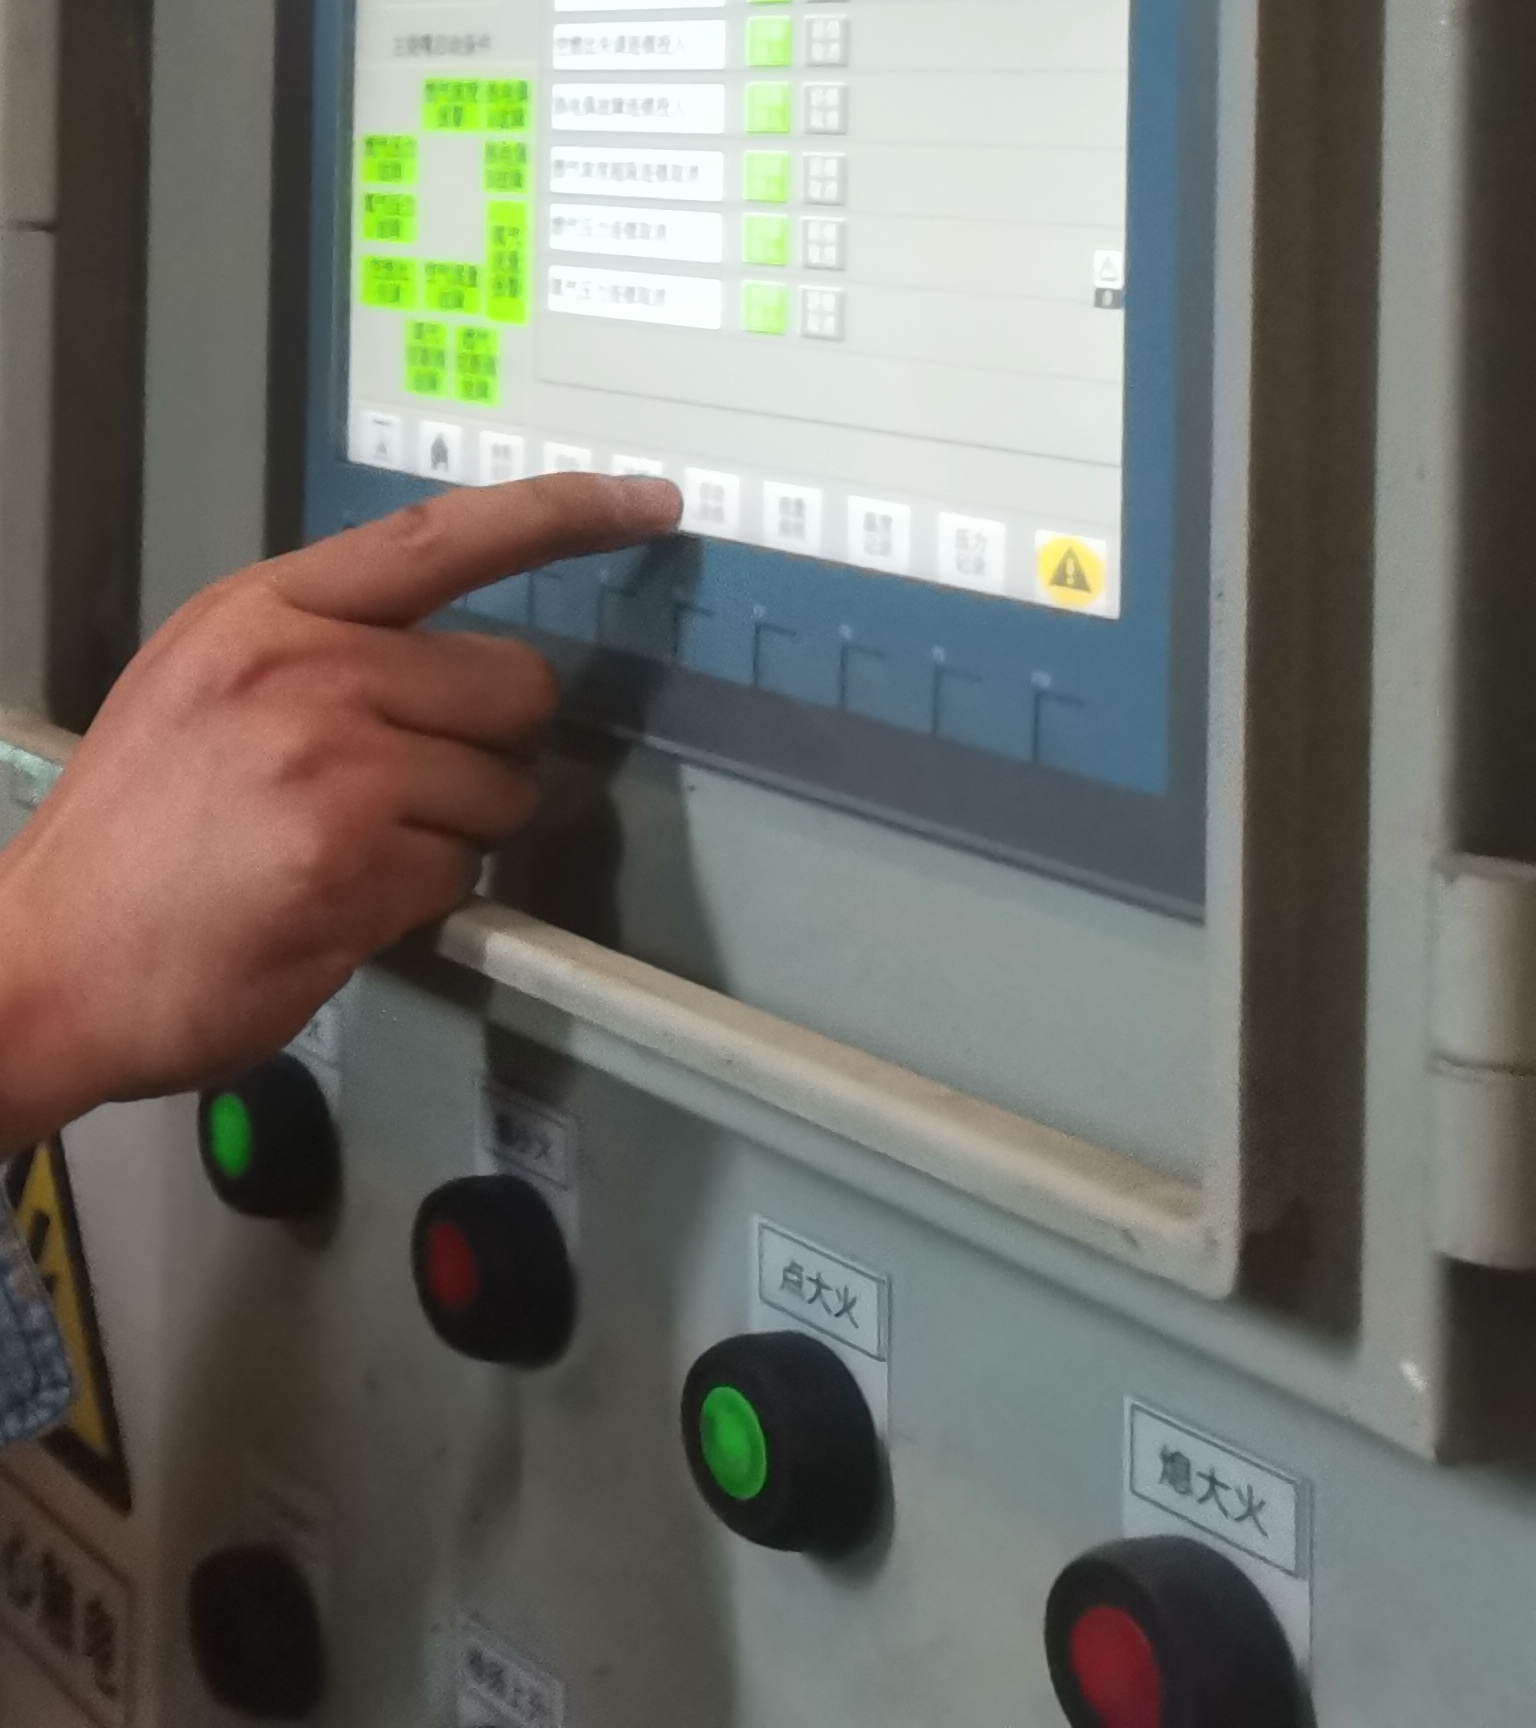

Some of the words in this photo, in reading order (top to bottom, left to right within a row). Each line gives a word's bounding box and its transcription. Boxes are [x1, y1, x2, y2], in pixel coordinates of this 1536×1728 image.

[780, 1260, 859, 1329] 点大火
[1158, 1444, 1270, 1540] 熄大火
